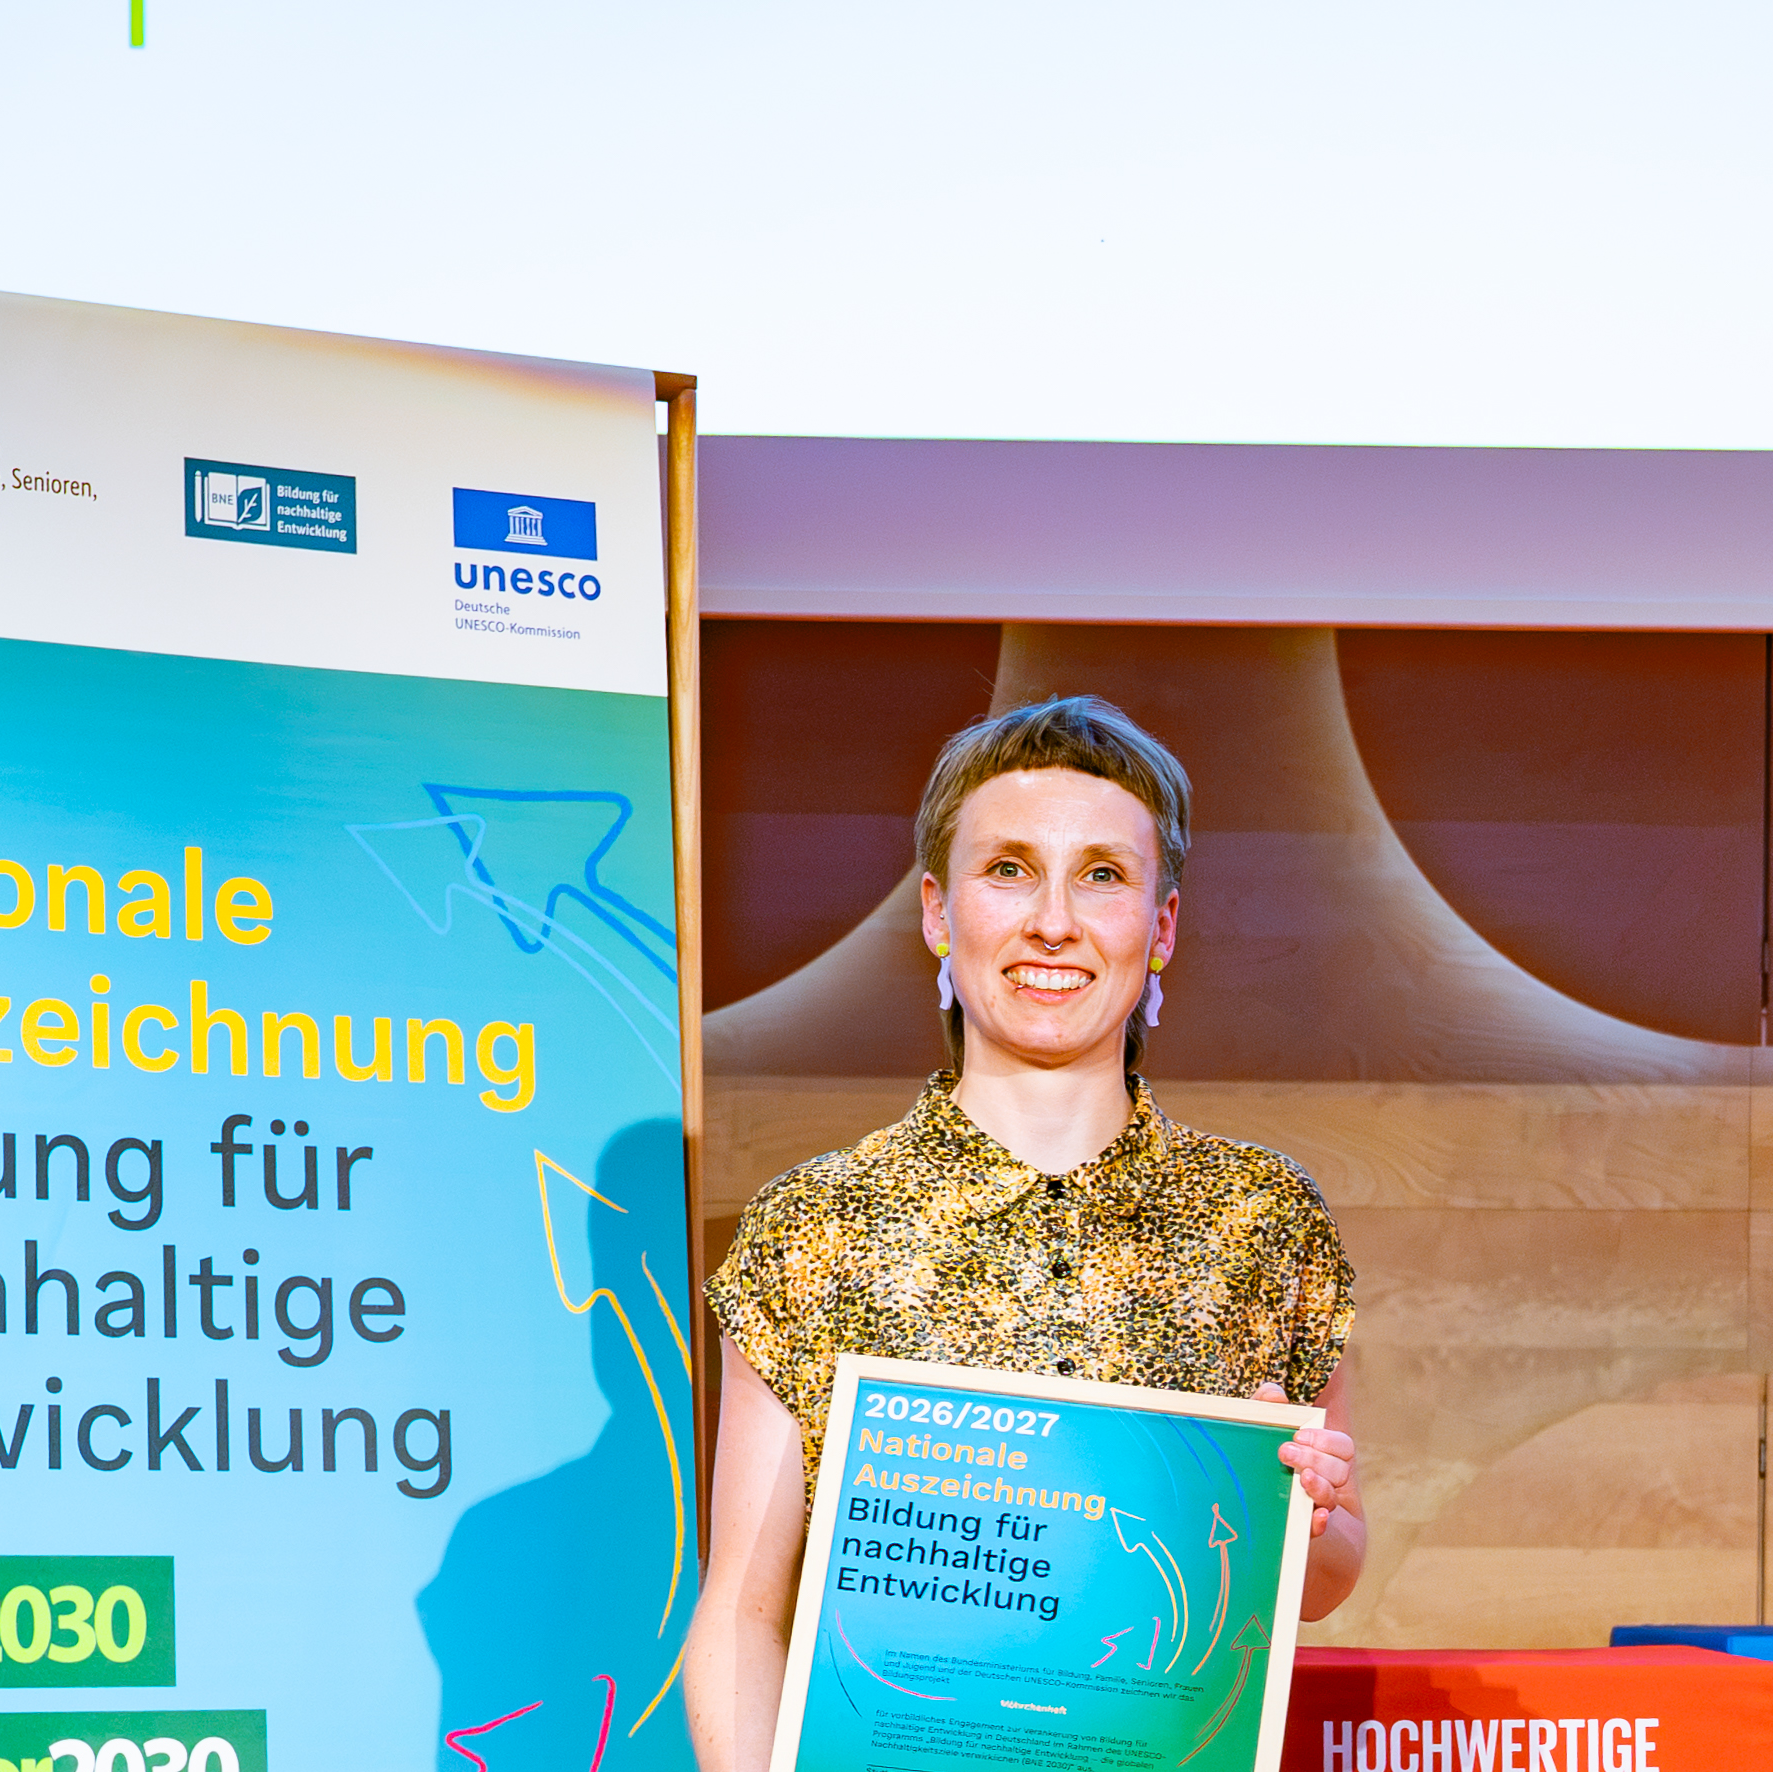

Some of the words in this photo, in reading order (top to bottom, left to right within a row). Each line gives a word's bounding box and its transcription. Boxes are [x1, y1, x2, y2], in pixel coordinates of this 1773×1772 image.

[12, 468, 98, 502] Senioren,
[211, 493, 234, 506] BNE
[277, 485, 321, 504] Bildung
[322, 489, 339, 504] für
[277, 505, 343, 524] nachhaltige
[277, 520, 347, 542] Entwicklung
[454, 562, 601, 601] unesco
[454, 598, 511, 616] Deutsche
[455, 617, 581, 640] UNESCO-Kommission
[210, 1113, 374, 1211] für
[864, 1393, 1060, 1437] 2026/2027
[858, 1428, 1028, 1470] Nationale
[853, 1463, 1106, 1521] Auszeichnung
[848, 1497, 981, 1541] Bildung
[995, 1512, 1048, 1542] für
[842, 1536, 1051, 1582] nachhaltige
[836, 1566, 1060, 1622] Entwicklung
[882, 1669, 951, 1684] Bildungsprojekt
[883, 1660, 901, 1668] und
[902, 1662, 936, 1672] Jugend
[938, 1667, 956, 1675] und
[957, 1668, 973, 1676] der
[974, 1670, 1022, 1682] Deutschen
[1024, 1676, 1119, 1693] UNESCO-Kommission
[1162, 1691, 1177, 1699] wir
[899, 1650, 930, 1661] Namen
[932, 1654, 948, 1663] des
[1042, 1667, 1055, 1675] für
[874, 1721, 926, 1733] nachhaltige
[928, 1726, 982, 1739] Entwicklung
[995, 1733, 1051, 1747] Deutschland
[875, 1709, 889, 1717] für
[890, 1712, 946, 1725] vorbildliches
[949, 1717, 1005, 1732] Engagement
[1099, 1736, 1133, 1747] Bildung
[1135, 1739, 1148, 1748] für
[872, 1730, 924, 1742] Programms
[965, 1740, 979, 1748] für
[981, 1743, 1032, 1756] nachhaltige
[1034, 1748, 1089, 1763] Entwicklung
